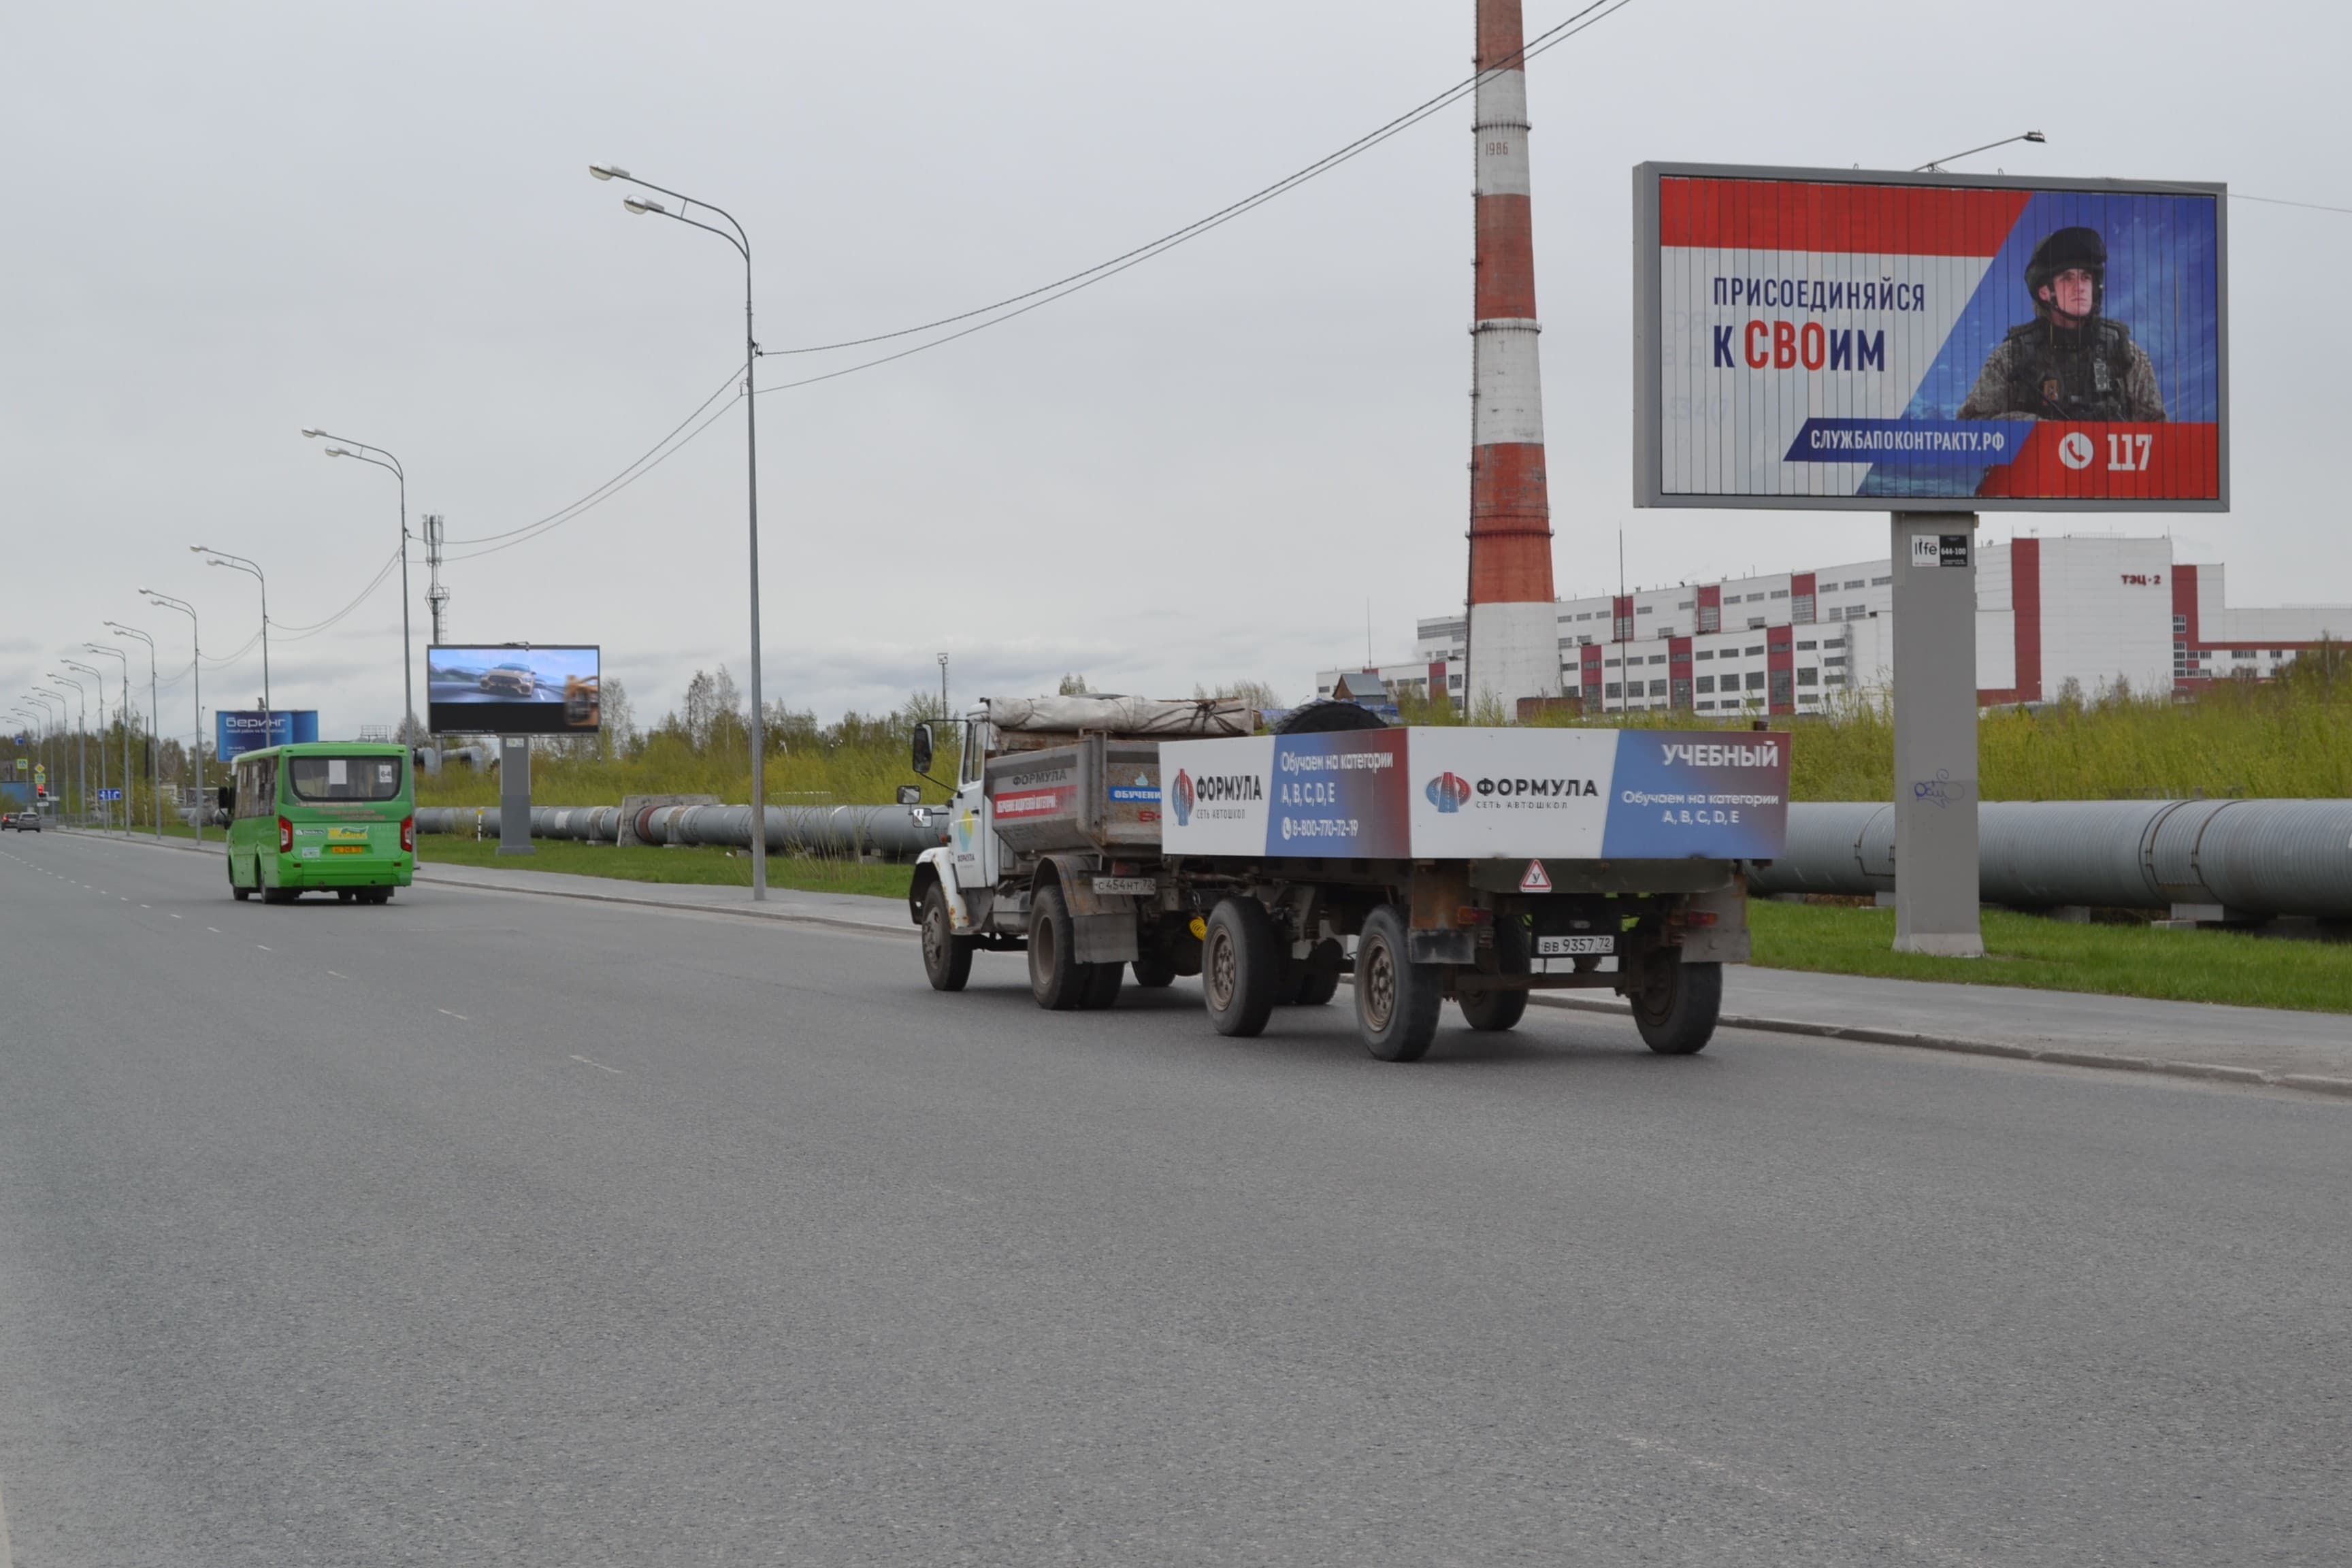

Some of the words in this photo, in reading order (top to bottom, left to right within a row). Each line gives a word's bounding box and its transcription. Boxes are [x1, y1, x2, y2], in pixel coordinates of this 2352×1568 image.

[1486, 142, 1509, 157] 1986
[1714, 276, 1925, 312] ПРИСОЕДИНЯЙСЯ
[1714, 325, 1735, 368] К
[1744, 319, 1884, 372] СВОИМ
[1810, 429, 2005, 451] СЛУЖБАПОКОНТРАКТУ.РФ
[2107, 434, 2153, 471] 117
[1941, 546, 1966, 555] 644-100
[1661, 740, 1779, 767] УЧЕБНЫЙ
[1281, 751, 1324, 776] Обучаем
[1326, 755, 1339, 770] на
[1341, 753, 1394, 774] категории
[1013, 770, 1068, 786] ФОРМУЛА
[1196, 775, 1262, 802] ФОРМУЛА
[1476, 778, 1599, 797] ФОРМУЛА
[1507, 801, 1567, 809] АВТОШКОЛ
[1622, 790, 1685, 806] Обучаем
[1688, 794, 1706, 804] на
[1709, 794, 1779, 807] категории
[1197, 809, 1209, 819] СЕТЬ
[1213, 809, 1246, 819] АВТОШКОЛ
[1292, 819, 1358, 836] 8-800-770-72-19
[1563, 938, 1594, 952] 9357
[1599, 938, 1612, 948] 72
